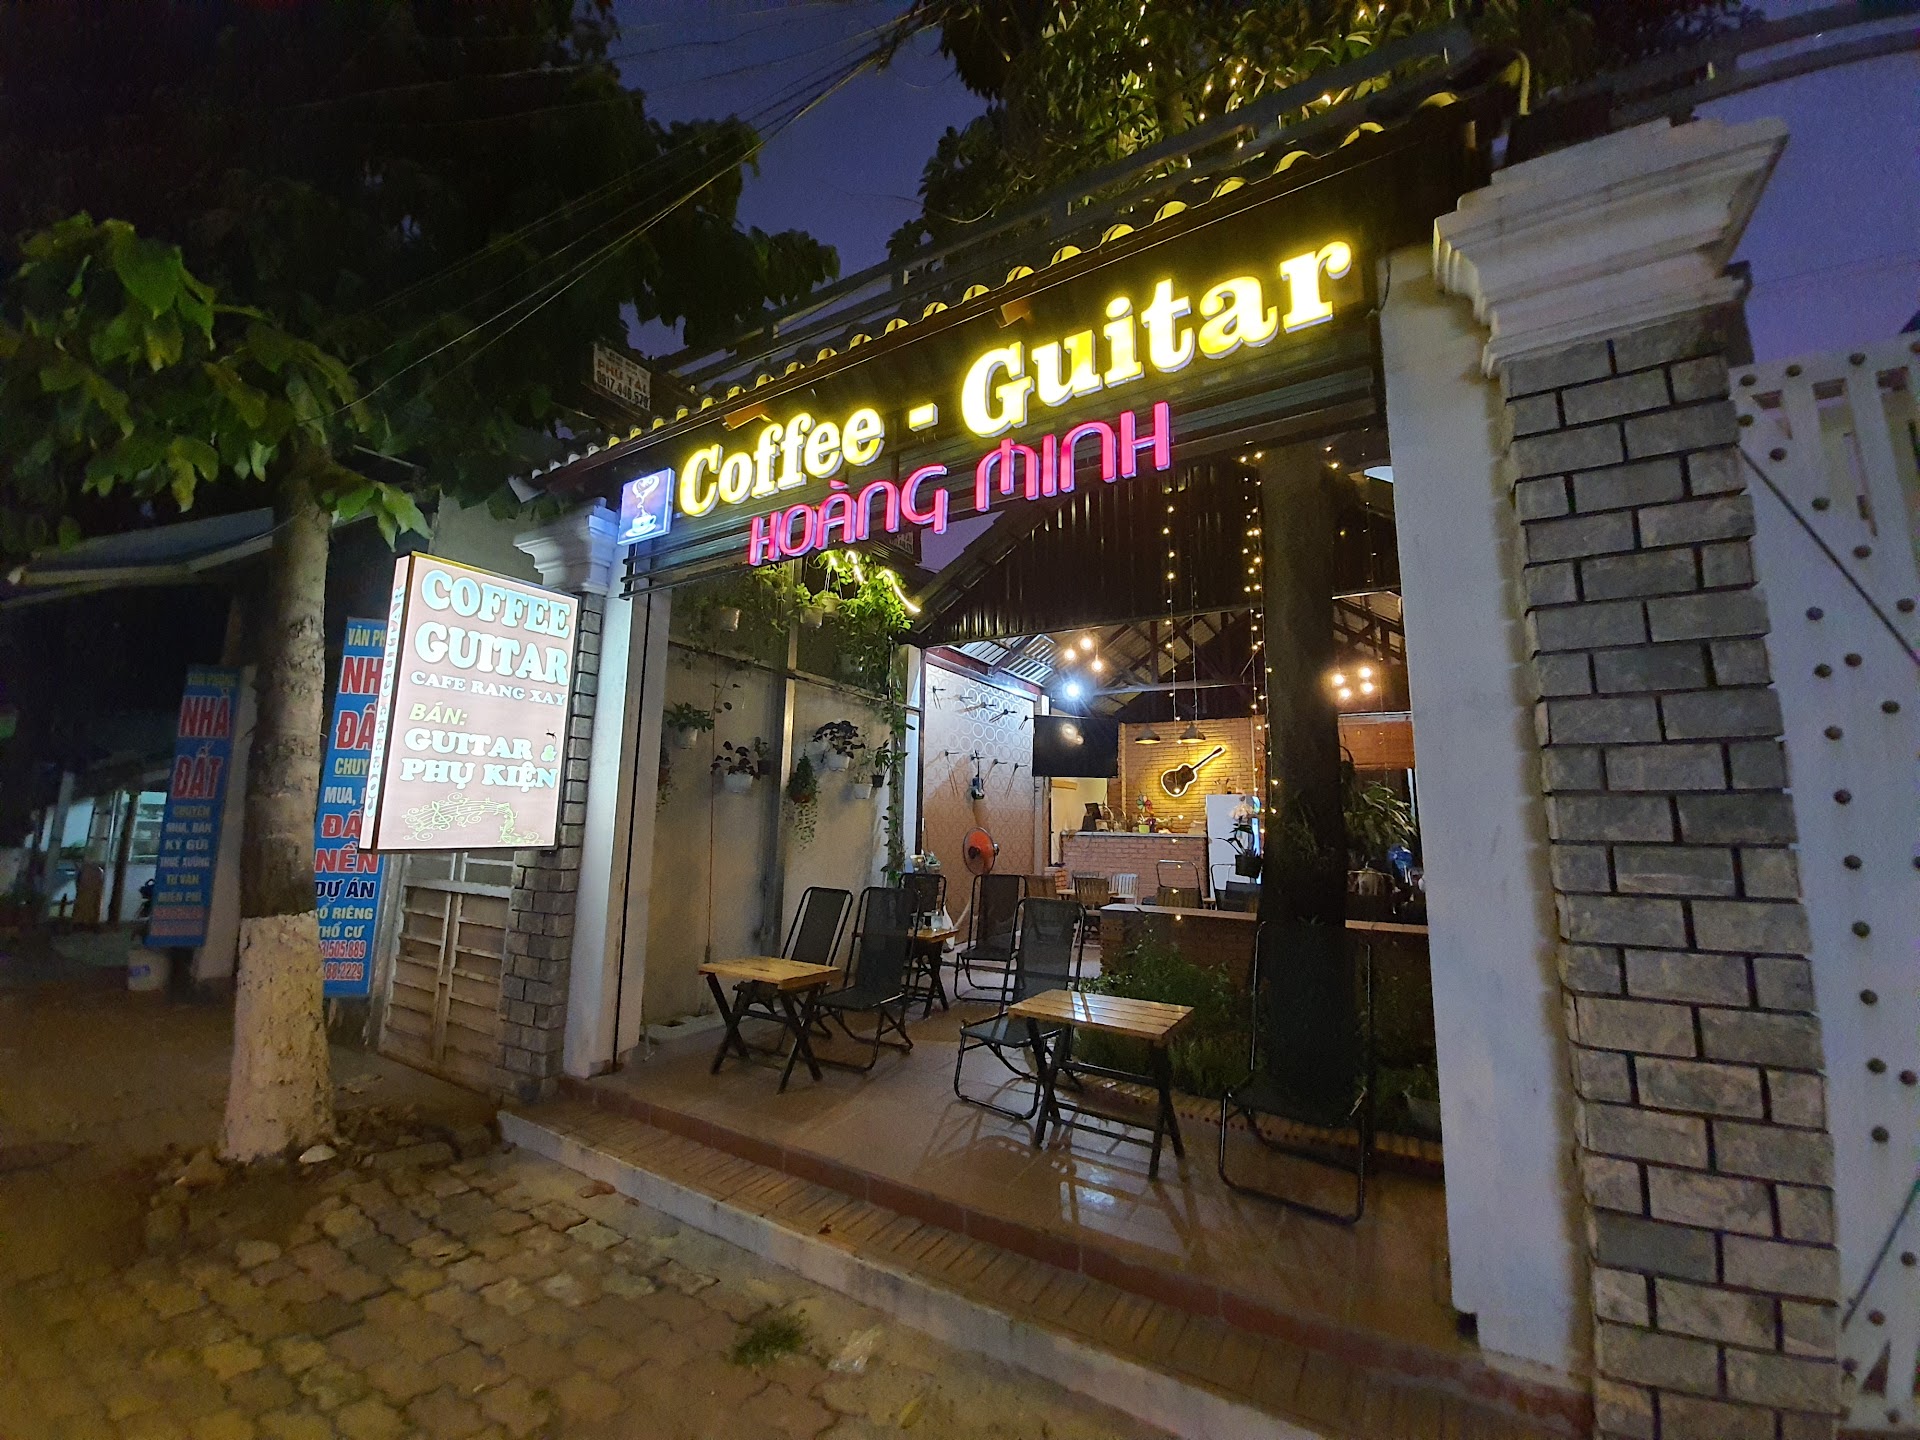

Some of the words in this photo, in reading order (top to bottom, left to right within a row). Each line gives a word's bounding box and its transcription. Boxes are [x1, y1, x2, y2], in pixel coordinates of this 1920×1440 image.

[679, 407, 885, 517] Coffee
[960, 241, 1352, 438] Guitar
[749, 463, 948, 566] HOÀNG
[974, 400, 1171, 512] MINH
[421, 569, 571, 639] COFFEE
[348, 625, 371, 647] VĂN
[414, 621, 569, 686] GUITAR
[410, 671, 467, 692] CAFE
[470, 680, 526, 701] RANG
[528, 689, 567, 706] XAY
[408, 701, 469, 726] BÁN:
[404, 727, 534, 761] GUITAR
[400, 758, 477, 790] PHỤ
[481, 760, 559, 793] KIỆN
[324, 786, 357, 807] MUA,
[314, 841, 380, 874] NỀN
[315, 878, 344, 902] DỰ
[344, 877, 376, 899] ÁN
[332, 904, 374, 920] RIÊNG
[344, 925, 365, 938] CƯ
